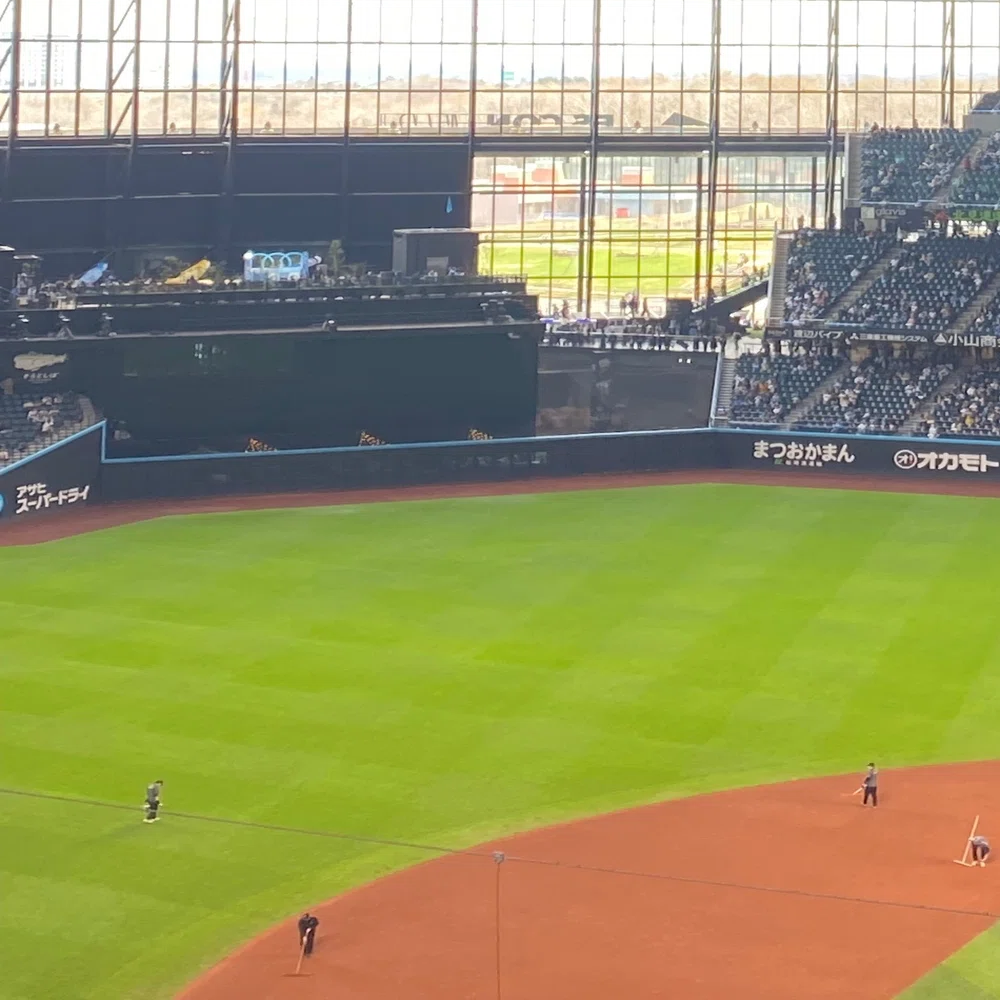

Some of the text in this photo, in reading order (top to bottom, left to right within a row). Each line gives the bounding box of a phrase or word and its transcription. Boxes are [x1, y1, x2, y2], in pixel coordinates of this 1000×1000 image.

[753, 440, 855, 463] まつおかまん
[916, 451, 1000, 473] オカモト
[16, 482, 47, 498] アサヒ
[16, 485, 90, 514] スーパードライ
